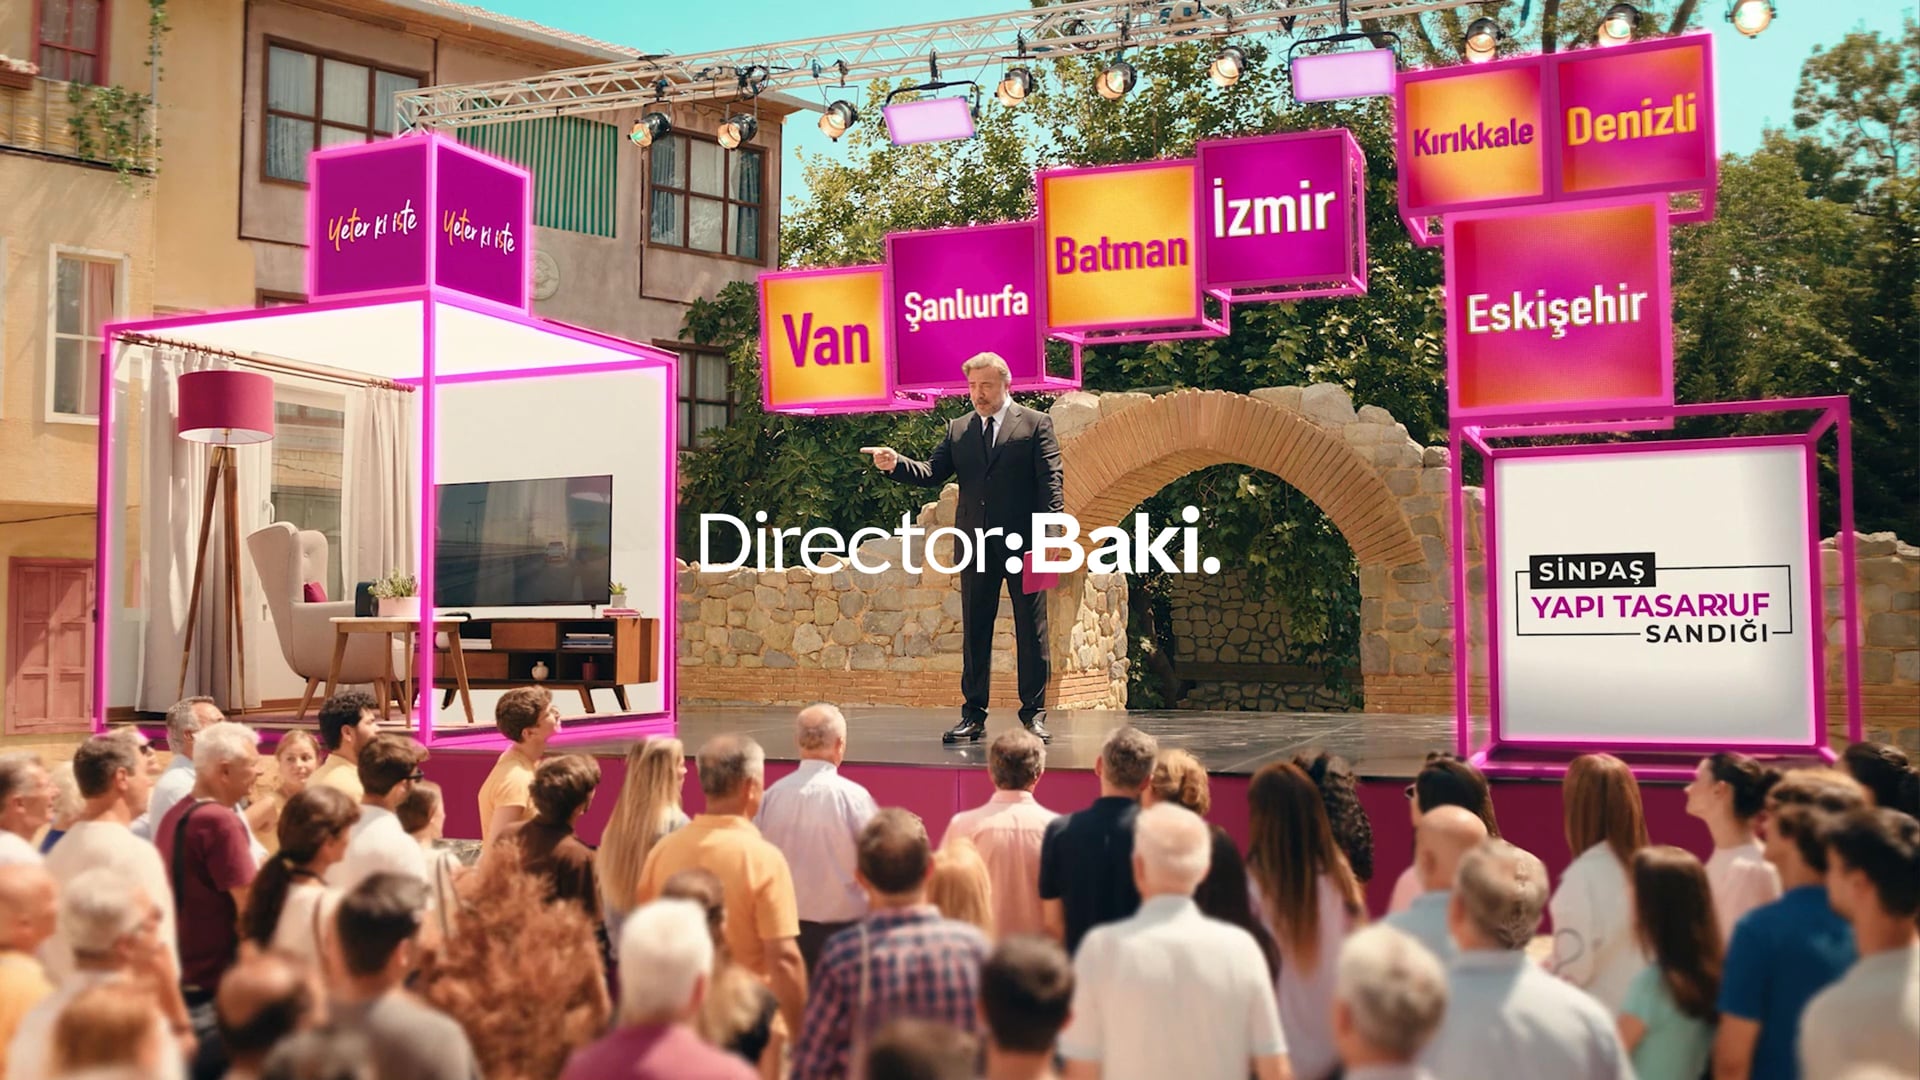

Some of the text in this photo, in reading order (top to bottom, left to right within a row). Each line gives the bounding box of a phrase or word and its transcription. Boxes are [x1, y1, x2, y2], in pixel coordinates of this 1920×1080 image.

[1413, 117, 1535, 157] Kırıkkale
[1566, 92, 1698, 146] Denizli
[328, 207, 371, 251] Yeter
[392, 199, 418, 235] iste
[443, 208, 478, 246] Yeter
[494, 222, 516, 255] iste
[1212, 177, 1337, 239] İzmir
[1055, 235, 1188, 275] Batman
[904, 283, 1030, 332] Şanlıurfa
[1466, 282, 1648, 340] Eskişehir
[782, 312, 870, 368] Van
[1538, 556, 1646, 585] SİNPAŞ
[1530, 592, 1770, 619] YAPI TASARRUF
[1645, 618, 1768, 643] SANDIĞI
